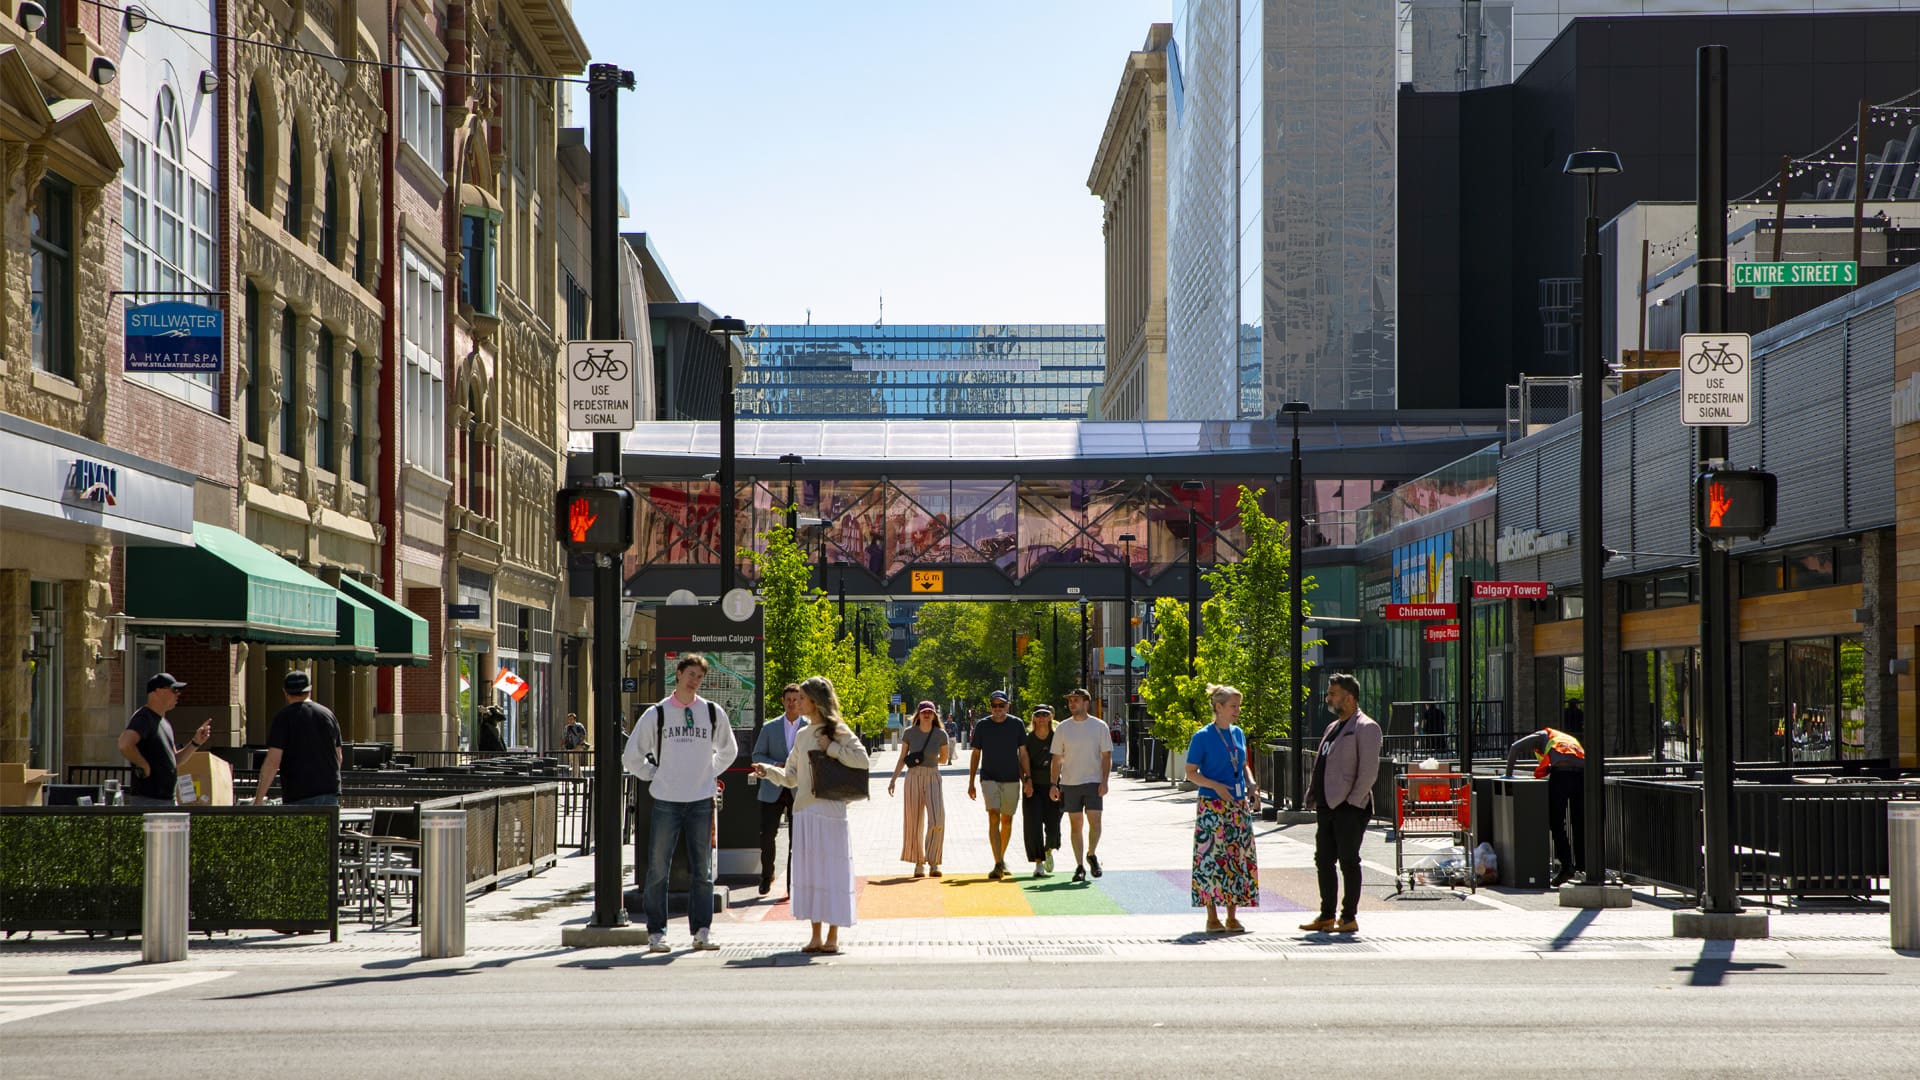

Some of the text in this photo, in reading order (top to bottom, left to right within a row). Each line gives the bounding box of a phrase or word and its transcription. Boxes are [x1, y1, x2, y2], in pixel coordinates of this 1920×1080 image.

[1736, 264, 1853, 283] CENTRE STREET S
[131, 314, 216, 328] STILLWATER
[129, 353, 218, 362] A HYATT SPA
[1706, 378, 1725, 389] USE
[591, 385, 610, 396] USE
[1688, 393, 1744, 404] PEDESTRIAN
[573, 399, 629, 411] PEDESTRIAN
[1699, 407, 1732, 418] SIGNAL
[584, 413, 617, 425] SIGNAL
[1476, 584, 1511, 597] Calgary
[1513, 585, 1541, 595] Tower
[1399, 607, 1446, 617] Chinatown
[691, 634, 755, 644] Downtown Calgary
[663, 726, 707, 738] CANMORE
